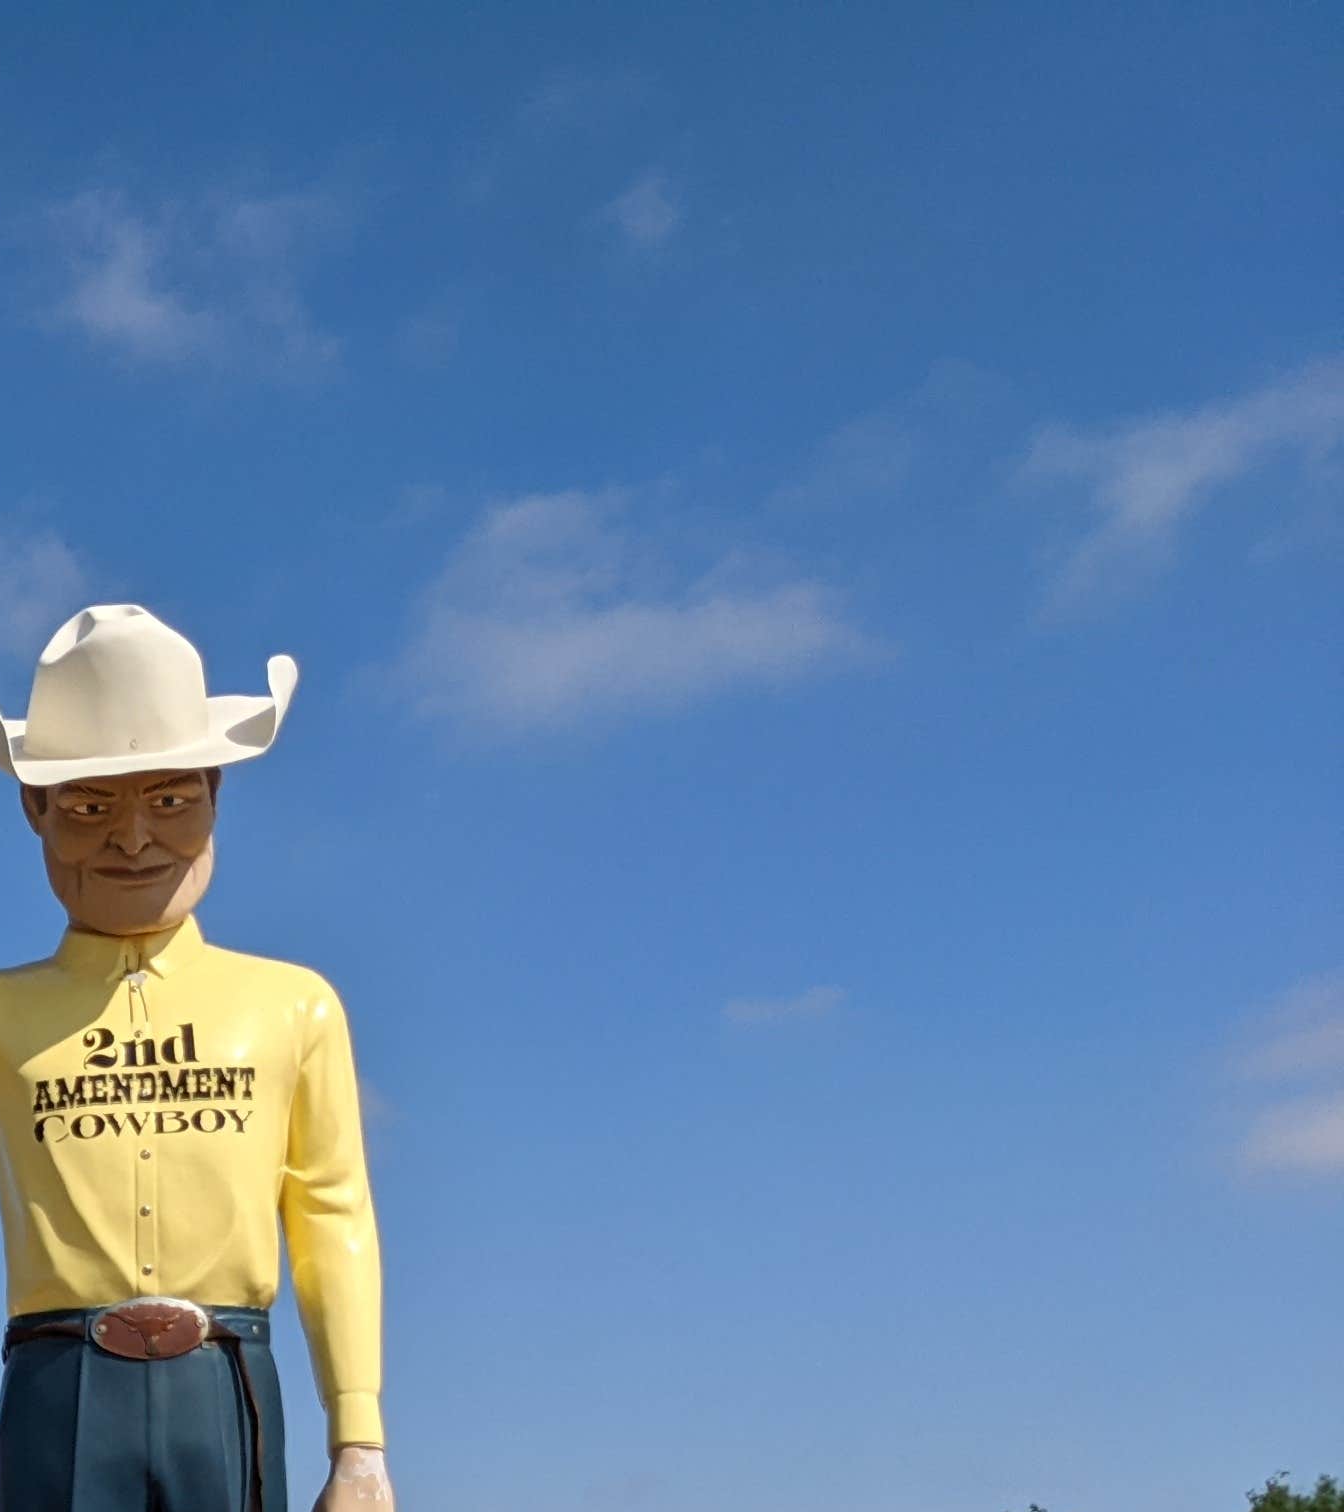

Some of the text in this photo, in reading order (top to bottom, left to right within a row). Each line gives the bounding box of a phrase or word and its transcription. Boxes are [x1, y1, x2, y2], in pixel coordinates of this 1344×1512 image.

[83, 1022, 199, 1069] 2nd
[33, 1067, 255, 1113] AMENDMENT
[33, 1109, 255, 1144] COWBOY
